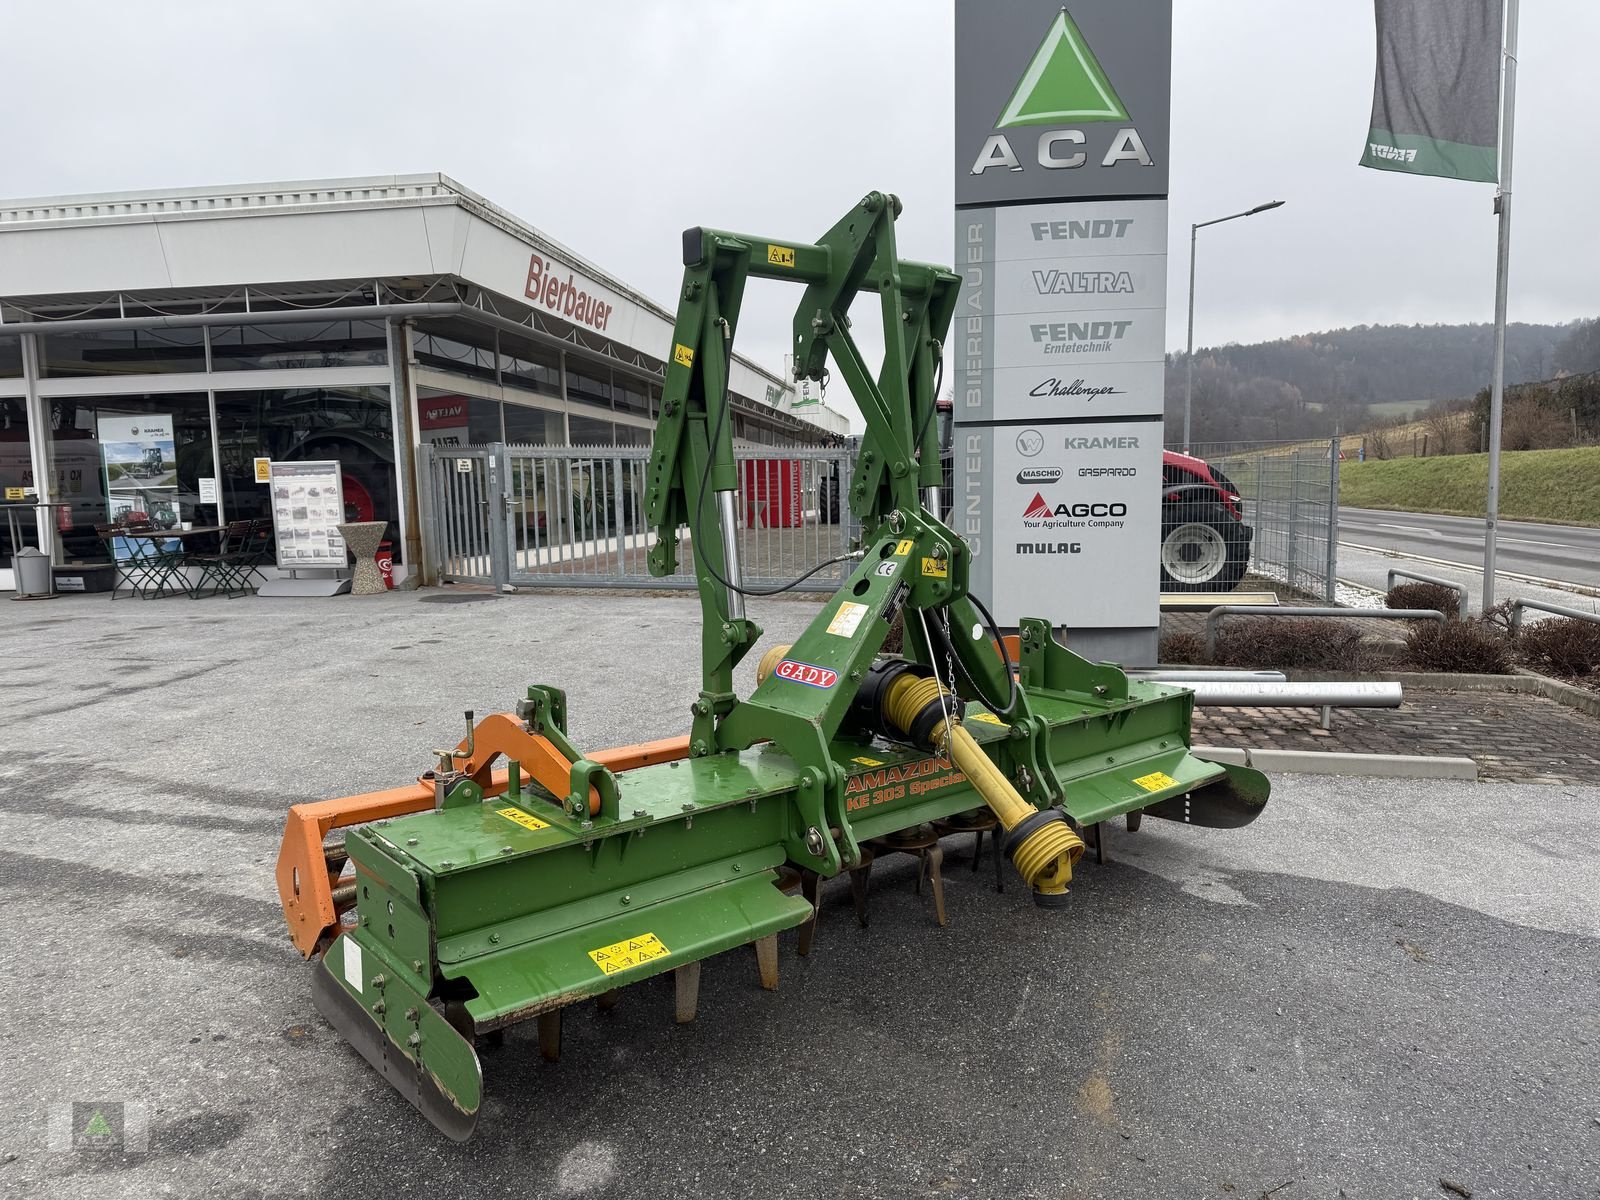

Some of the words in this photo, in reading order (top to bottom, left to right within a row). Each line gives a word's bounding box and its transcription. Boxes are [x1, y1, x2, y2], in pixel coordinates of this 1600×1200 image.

[969, 128, 1155, 175] ACA
[1031, 219, 1134, 241] FENDT
[525, 253, 613, 331] Bierbauer
[1032, 269, 1134, 294] VALTRA
[967, 223, 983, 407] BIERBAUER
[1030, 321, 1133, 342] FENDT
[1043, 341, 1112, 354] Erntetechnik
[1029, 378, 1128, 401] Challenger
[1064, 437, 1139, 449] KRAMER
[1023, 469, 1061, 478] MASCHIO
[1078, 467, 1137, 477] GASPARDO
[1053, 503, 1127, 518] AGCO
[1023, 520, 1041, 529] Your
[1042, 520, 1086, 530] Agriculture
[1087, 519, 1125, 529] Company
[781, 663, 833, 685] GADY
[845, 756, 957, 796] AMAZON
[846, 793, 870, 811] KE
[873, 785, 905, 804] 303
